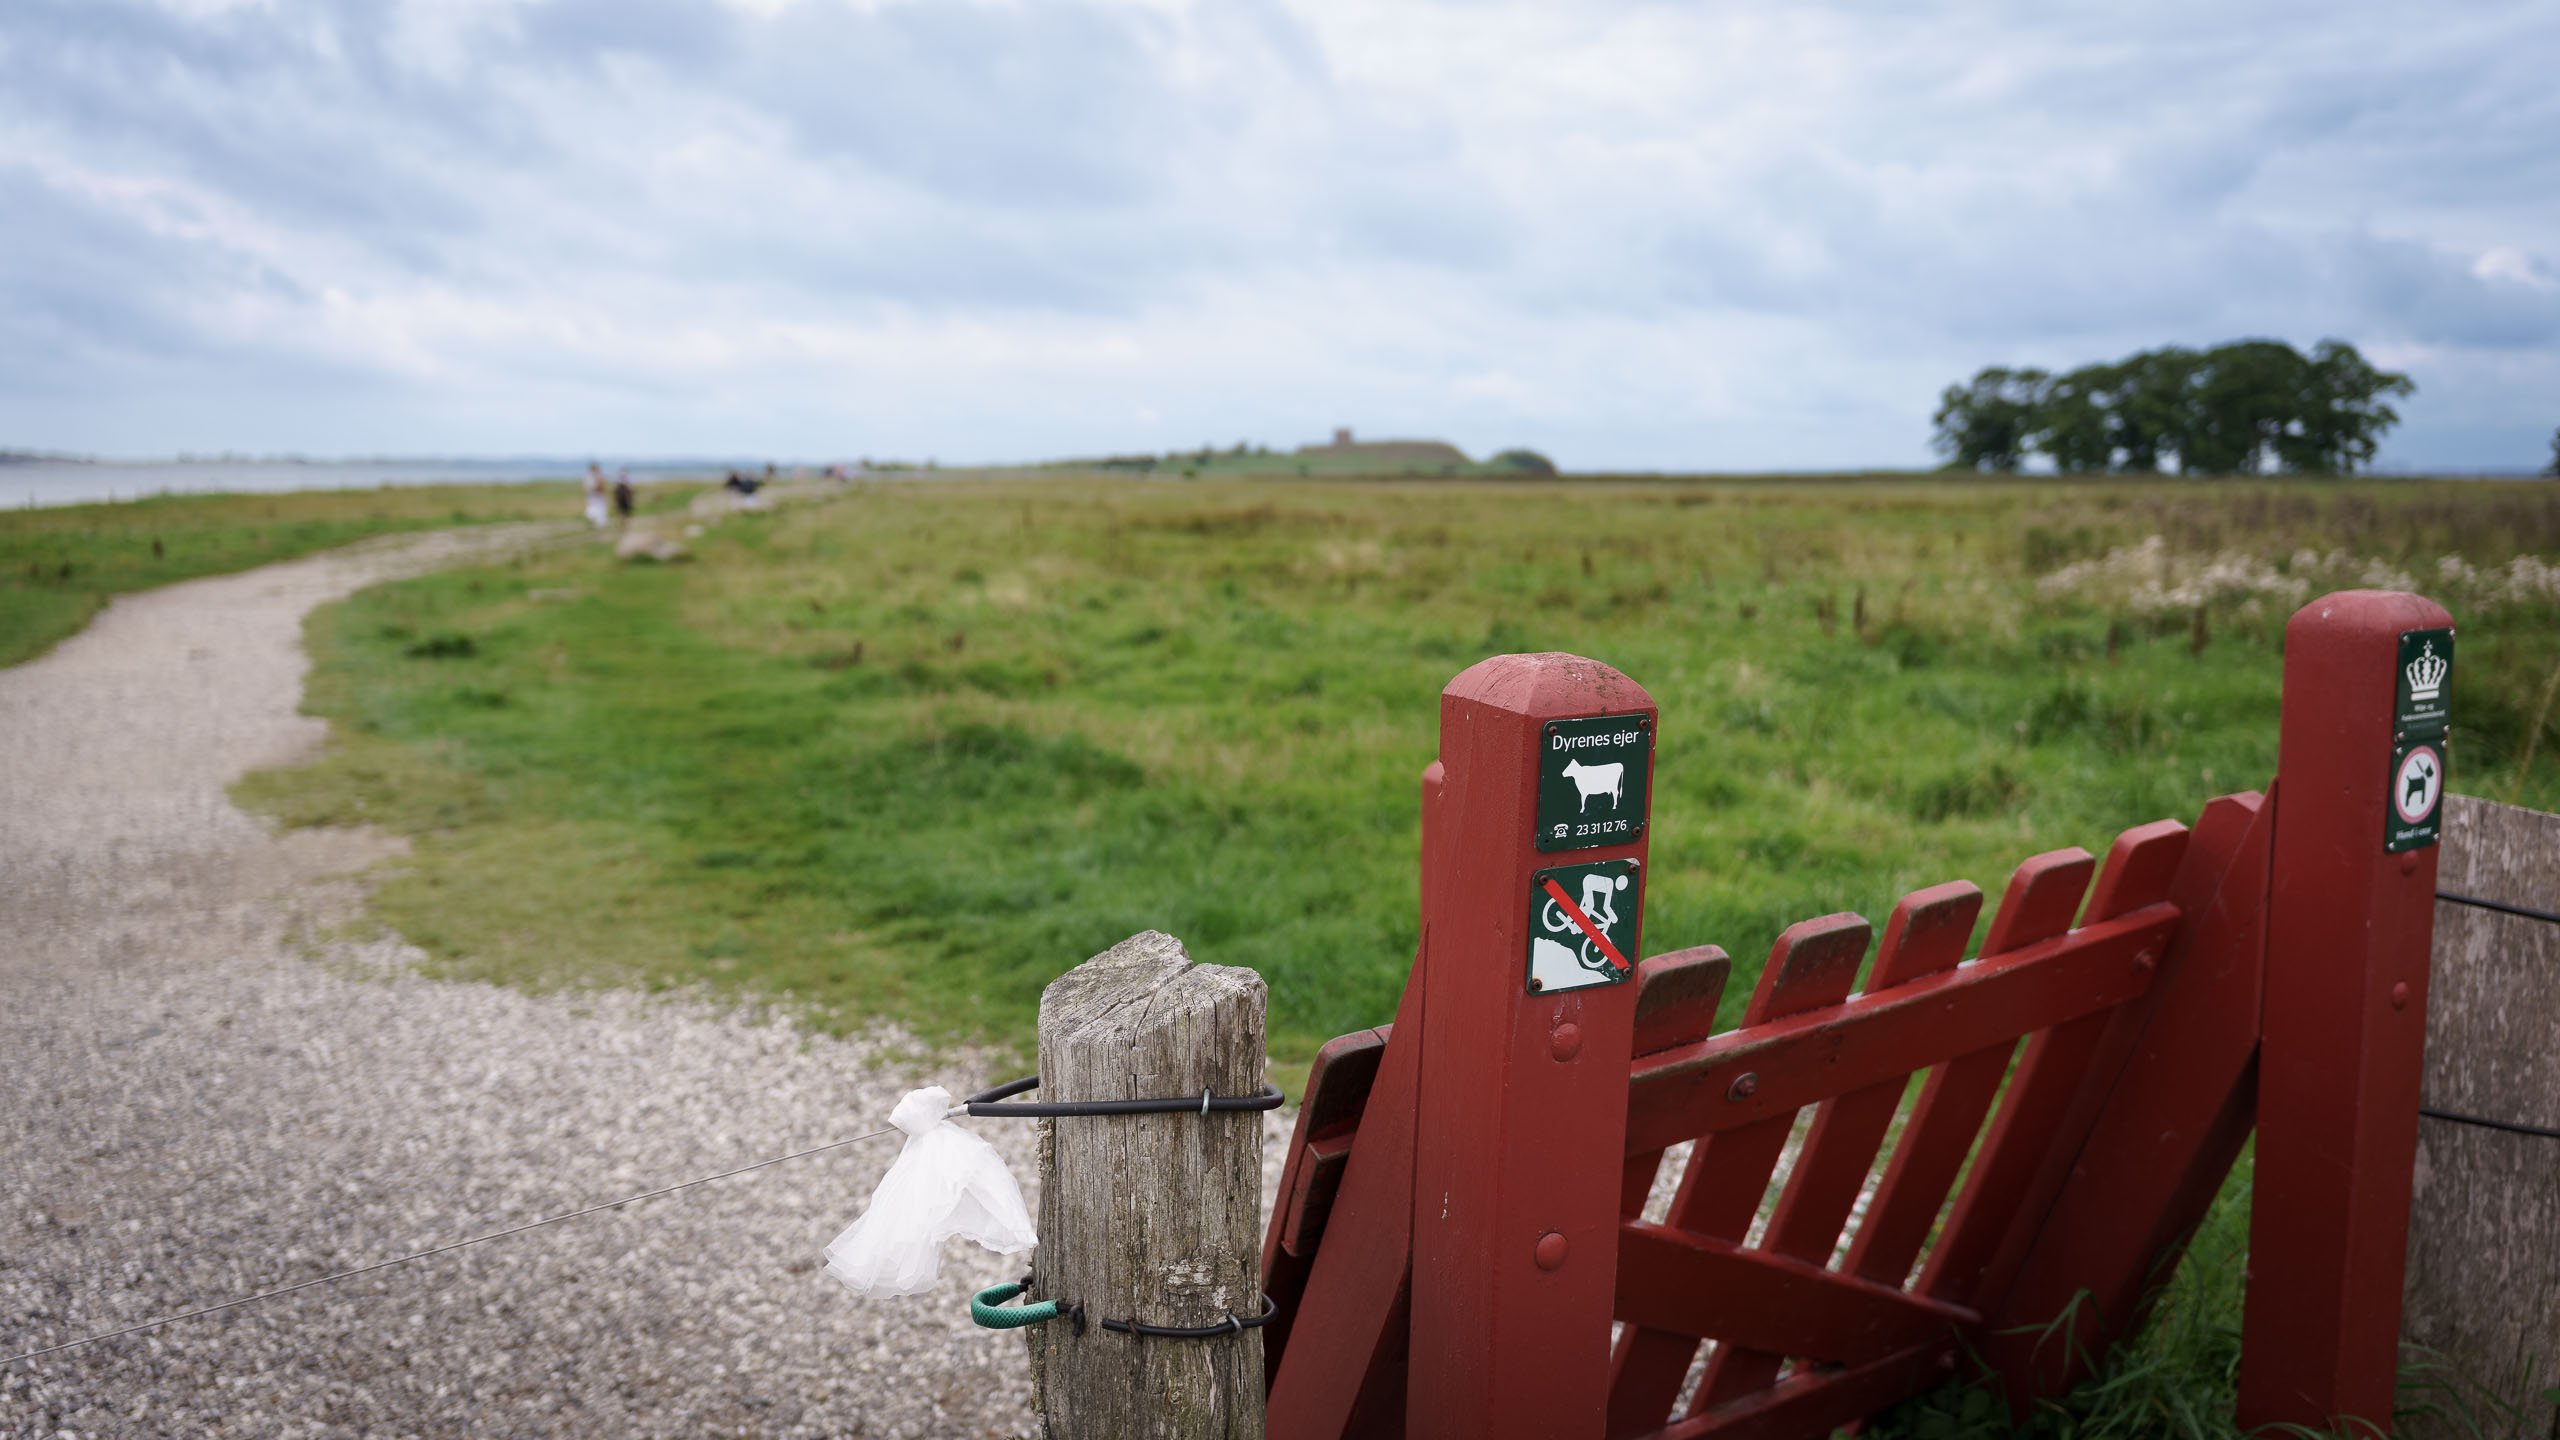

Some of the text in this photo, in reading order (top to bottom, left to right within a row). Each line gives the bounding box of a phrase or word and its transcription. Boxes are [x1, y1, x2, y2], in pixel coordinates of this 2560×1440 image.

[1552, 729, 1639, 752] Dyrenes ejer
[1576, 819, 1627, 836] 23 31 12 76
